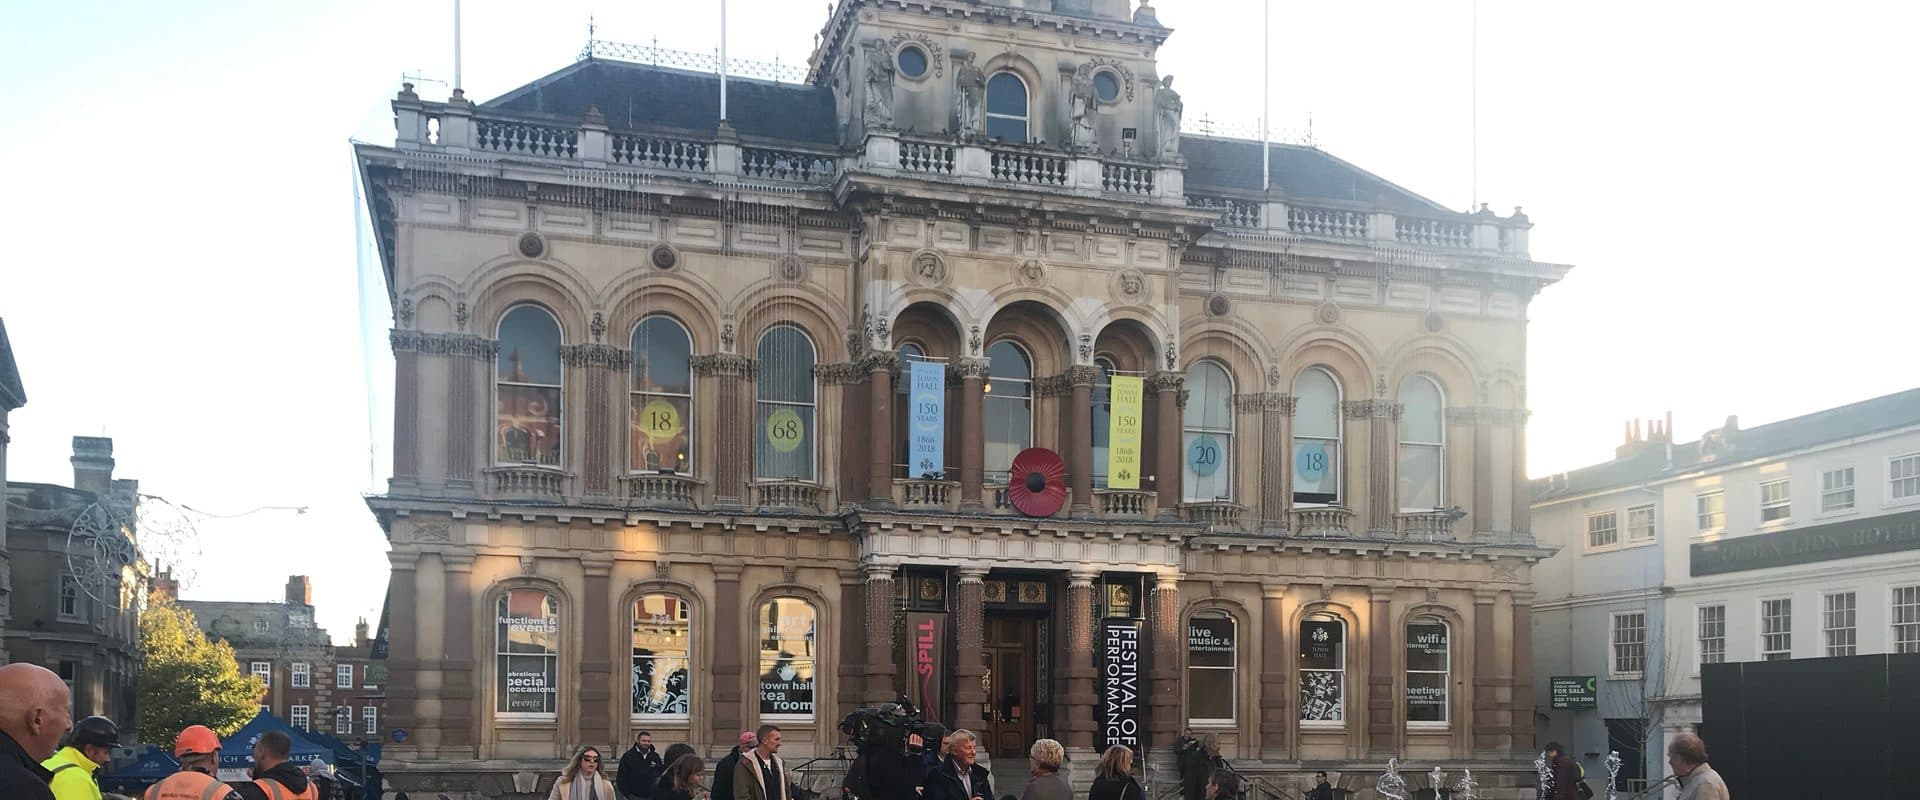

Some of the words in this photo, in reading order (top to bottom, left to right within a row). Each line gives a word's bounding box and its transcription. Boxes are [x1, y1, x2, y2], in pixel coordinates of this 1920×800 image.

[919, 403, 938, 415] 150
[650, 411, 672, 432] 18
[1118, 415, 1137, 427] 150
[773, 419, 798, 440] 68
[917, 445, 936, 453] 2018
[1116, 456, 1134, 464] 2018
[1195, 446, 1216, 465] 20
[1305, 452, 1323, 471] 18
[499, 616, 547, 625] functions
[511, 624, 557, 633] events
[1188, 626, 1212, 637] live
[1189, 636, 1221, 646] music
[1222, 637, 1230, 646] &
[1416, 633, 1439, 644] wifi
[917, 618, 935, 675] SPILL
[1121, 630, 1137, 713] FESTIVAL
[760, 682, 789, 690] town
[792, 681, 813, 690] hall
[1106, 629, 1120, 745] PERFORMANCE
[760, 690, 786, 701] tea
[511, 699, 541, 708] events
[773, 701, 813, 711] room
[1121, 719, 1137, 746] OF
[288, 754, 320, 762] ARKET
